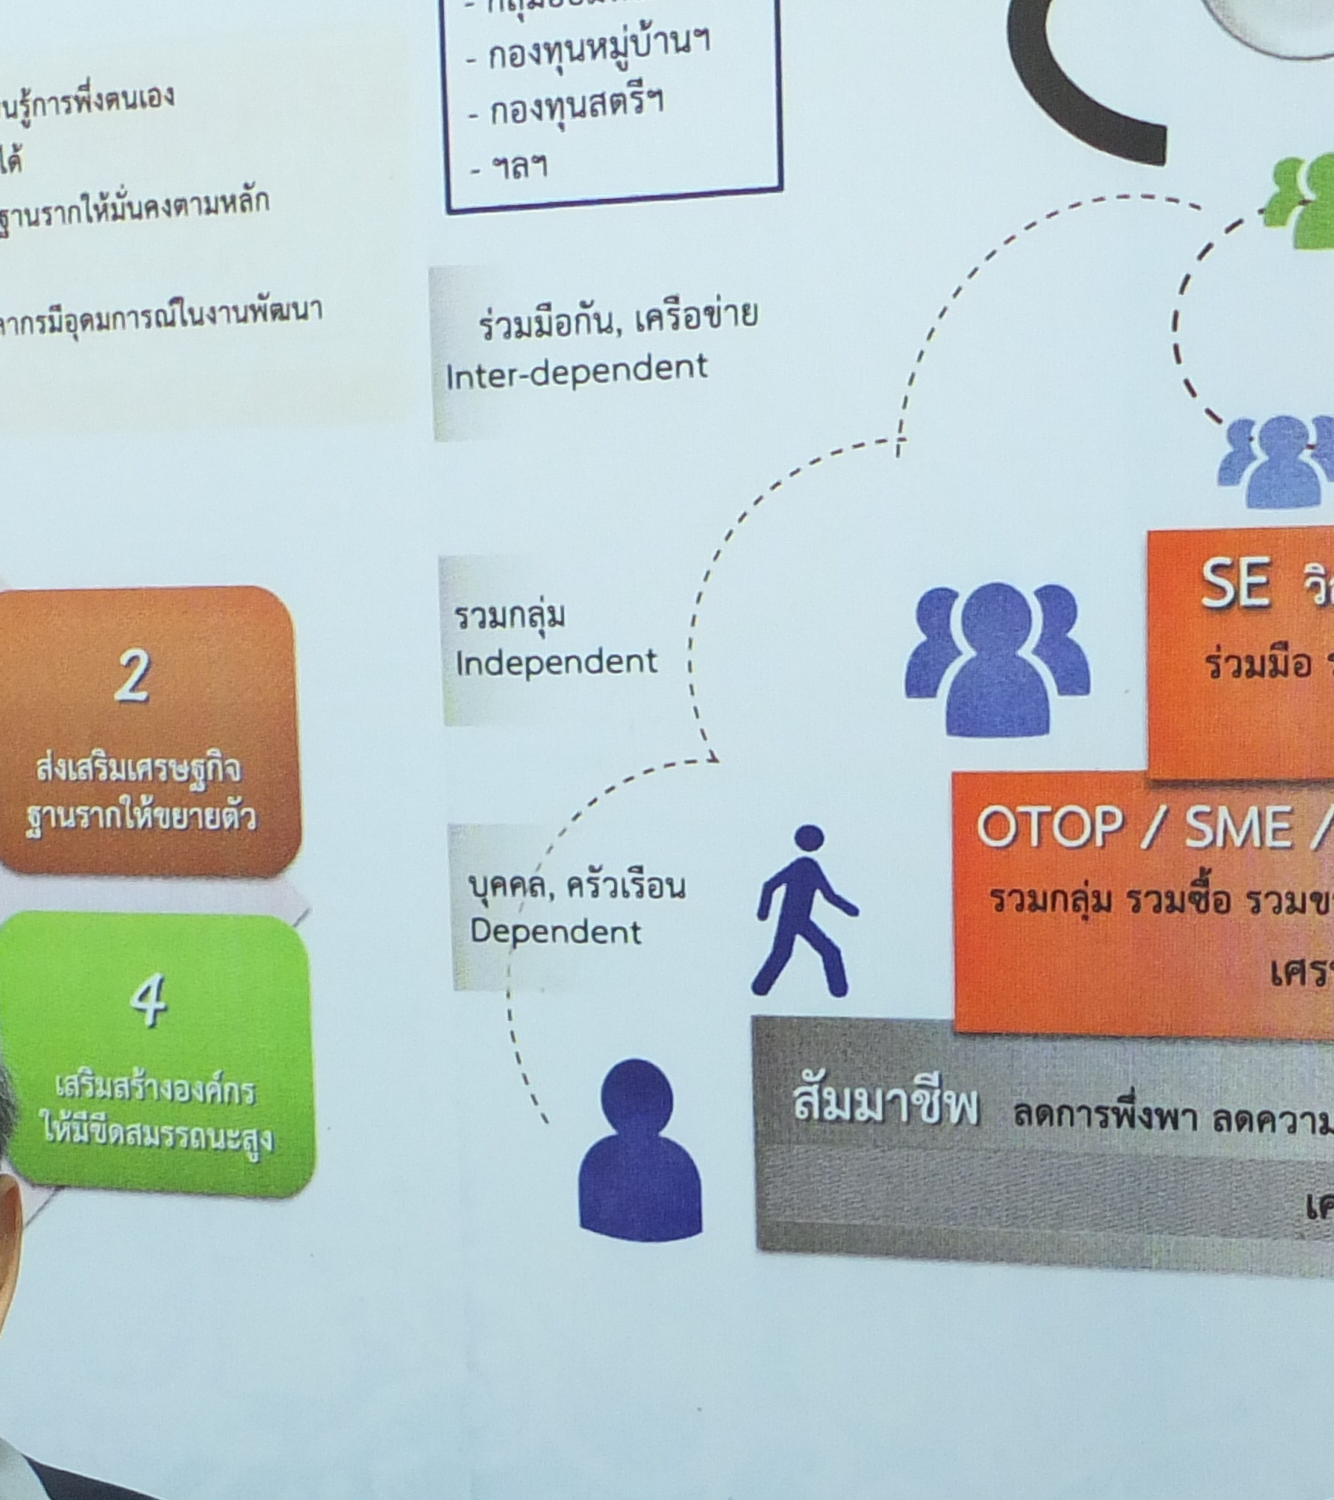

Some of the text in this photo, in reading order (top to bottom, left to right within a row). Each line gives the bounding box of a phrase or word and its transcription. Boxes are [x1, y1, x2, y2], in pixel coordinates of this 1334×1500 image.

[488, 19, 711, 76] กองทุนหมู่บ้านฯ
[491, 78, 665, 132] กองทุนสตรีฯ
[492, 152, 548, 180] ฯลฯ
[479, 294, 760, 341] ร่วมมือกัน, เครือข่าย
[447, 352, 710, 391] Inter-dependent
[1201, 555, 1272, 609] SE
[454, 596, 566, 640] รวมกลุ่ม
[113, 648, 151, 702] 2
[456, 648, 659, 682] Independent
[1205, 641, 1313, 680] ร่วมมือ
[35, 748, 242, 793] ส่งเสริมเศรษฐกิจ
[25, 797, 258, 839] ฐานรากให้ขยายตัว
[977, 804, 1124, 849] OTOP
[1185, 804, 1293, 849] SME
[469, 864, 687, 908] บุคคล, ครัวเรือน
[989, 879, 1113, 921] รวมกลุ่ม
[1127, 866, 1233, 916] รวมซื้อ
[470, 917, 642, 949] Dependent
[129, 972, 168, 1028] 4
[55, 1066, 257, 1107] เสริมสร้างองค์กร
[792, 1068, 981, 1128] สัมมาชีพ
[1014, 1086, 1199, 1135] ลดการพึ่งพา
[39, 1109, 275, 1164] ให้มีขีดสมรรถนะสูง
